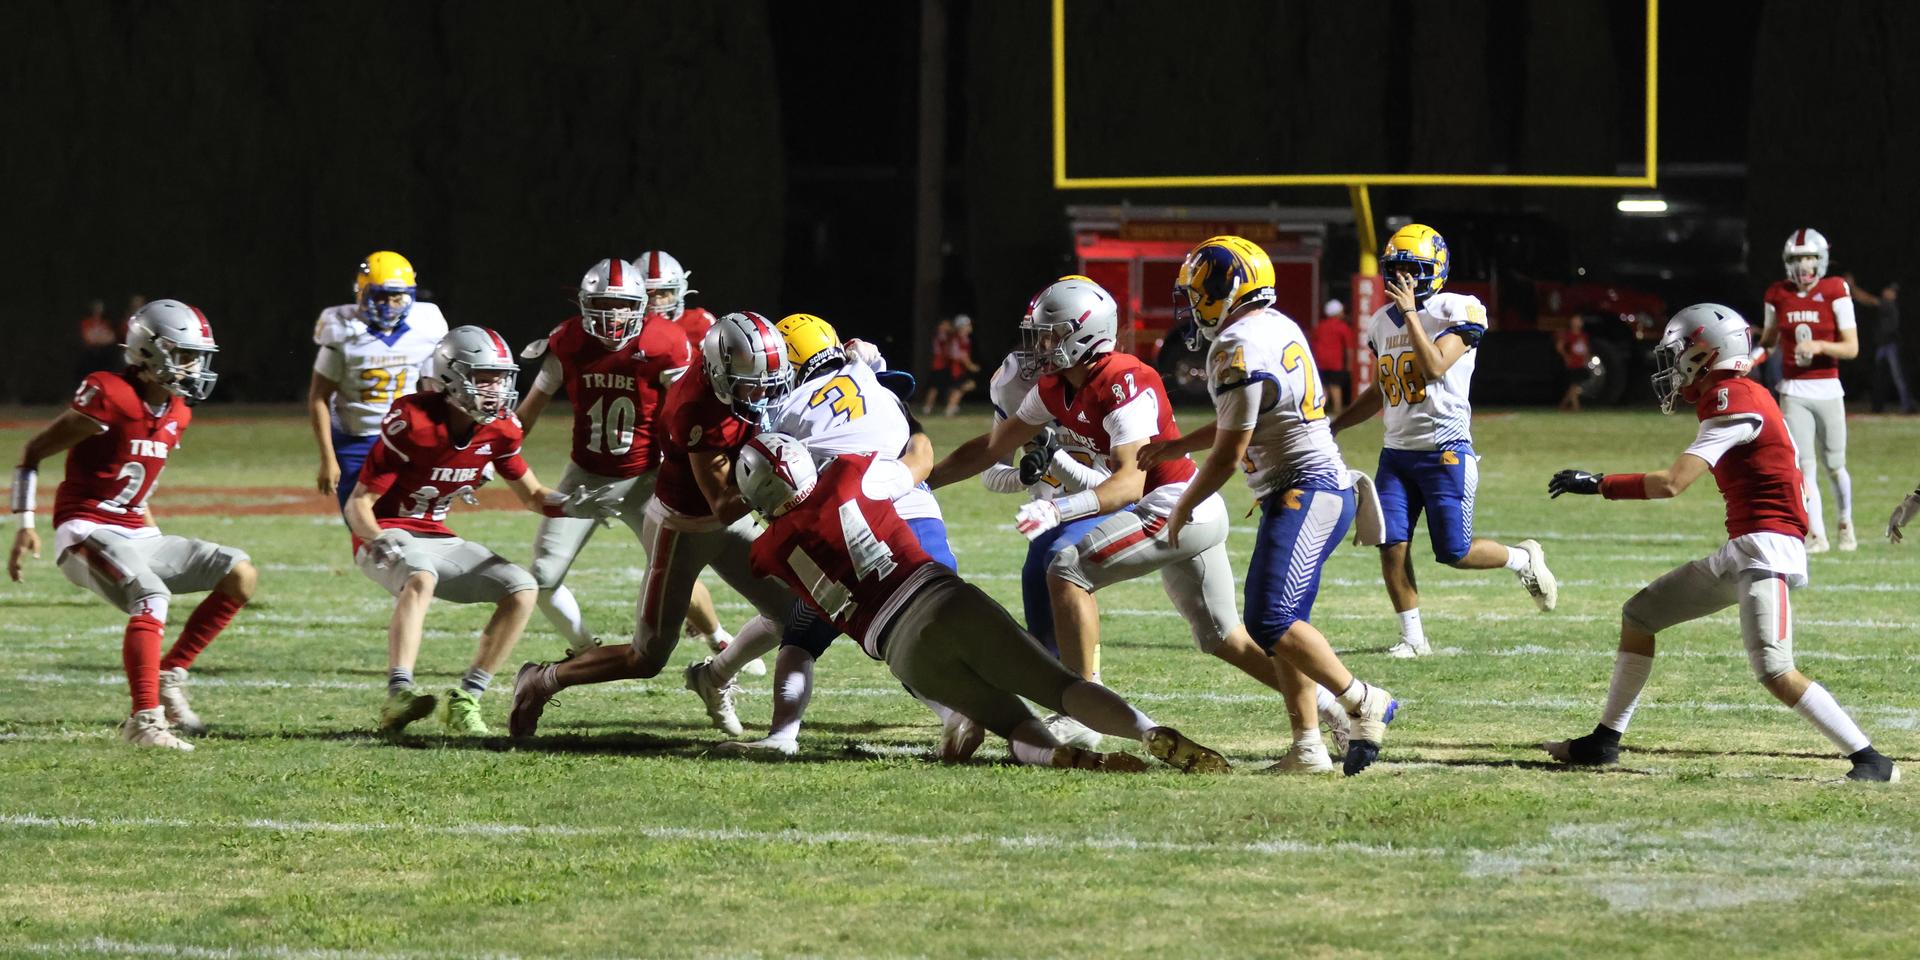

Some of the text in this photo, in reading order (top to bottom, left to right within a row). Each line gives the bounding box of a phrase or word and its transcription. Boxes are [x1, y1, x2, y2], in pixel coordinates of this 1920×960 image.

[361, 368, 408, 404] 21
[582, 373, 637, 392] TRIBE
[1111, 373, 1138, 405] 32
[1377, 350, 1427, 408] 88
[807, 374, 867, 427] 3
[1716, 387, 1729, 412] 5
[586, 395, 636, 456] 10
[687, 424, 703, 446] 9
[430, 467, 480, 482] TRIBE
[784, 482, 817, 511] Riddell
[786, 497, 899, 623] 44
